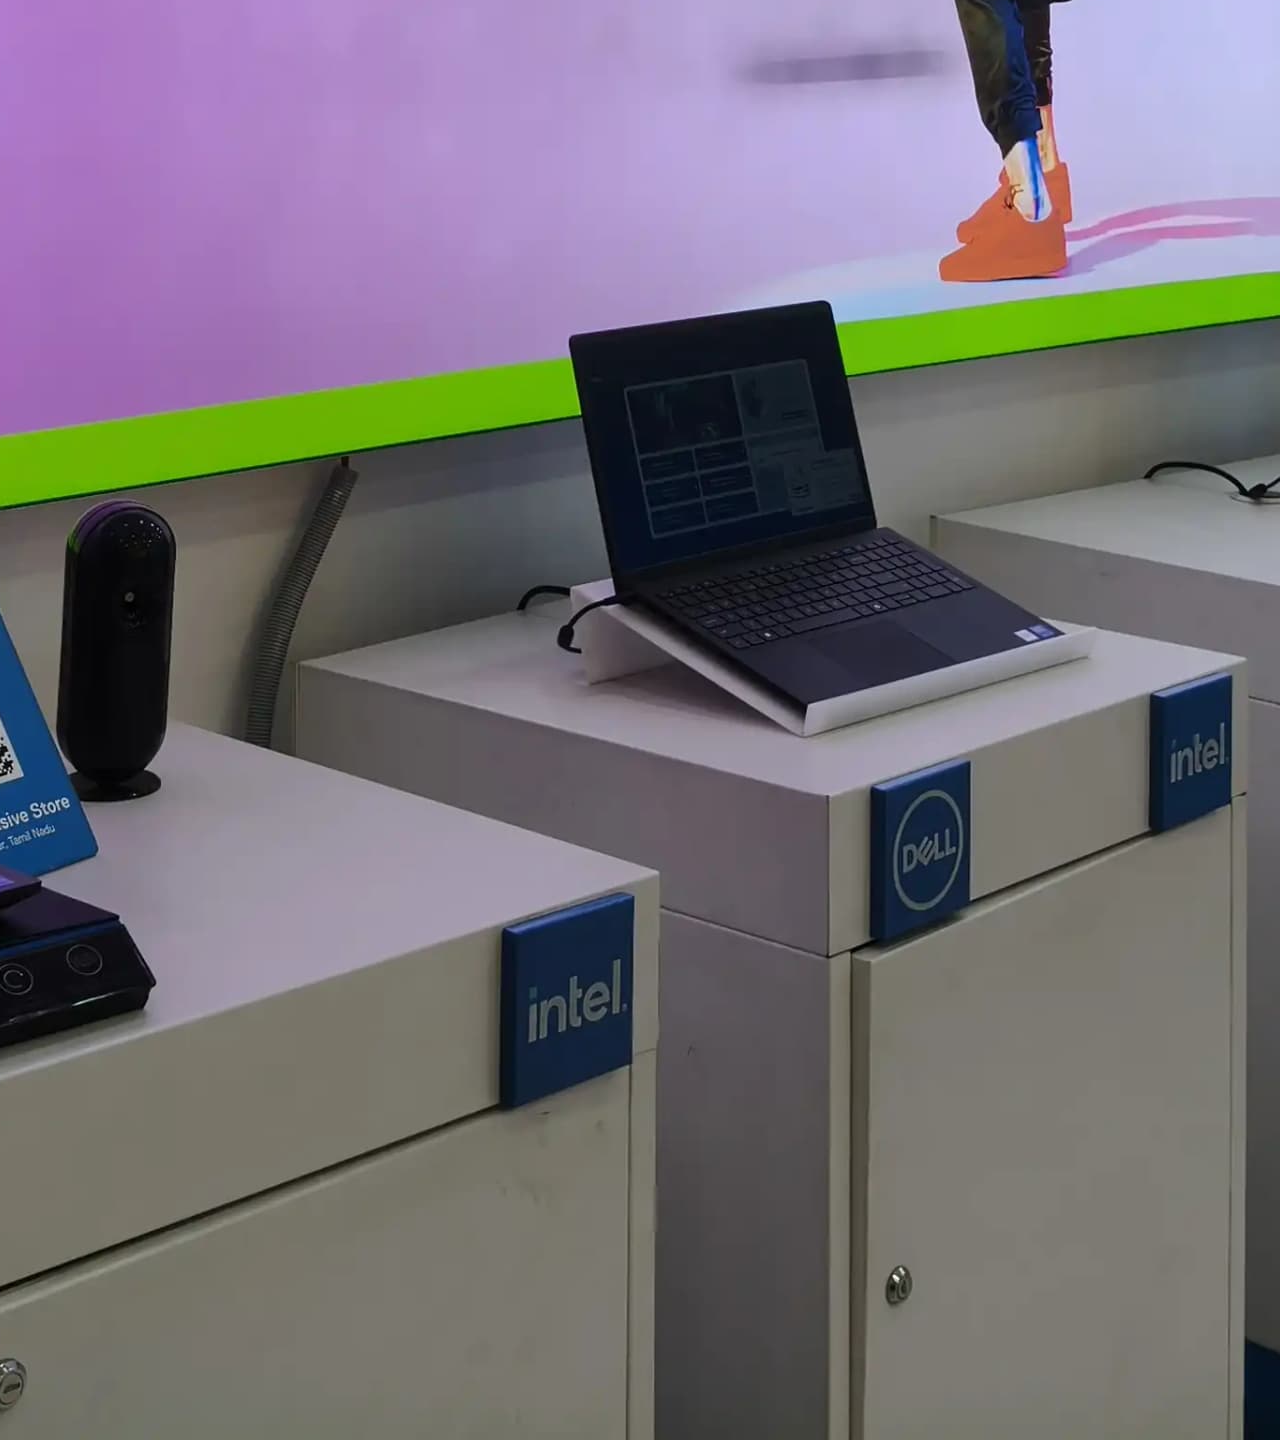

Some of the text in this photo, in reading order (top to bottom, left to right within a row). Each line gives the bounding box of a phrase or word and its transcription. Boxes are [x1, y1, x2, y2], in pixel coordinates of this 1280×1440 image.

[29, 797, 71, 819] Store
[7, 831, 33, 847] Tamil
[903, 828, 957, 874] DELL
